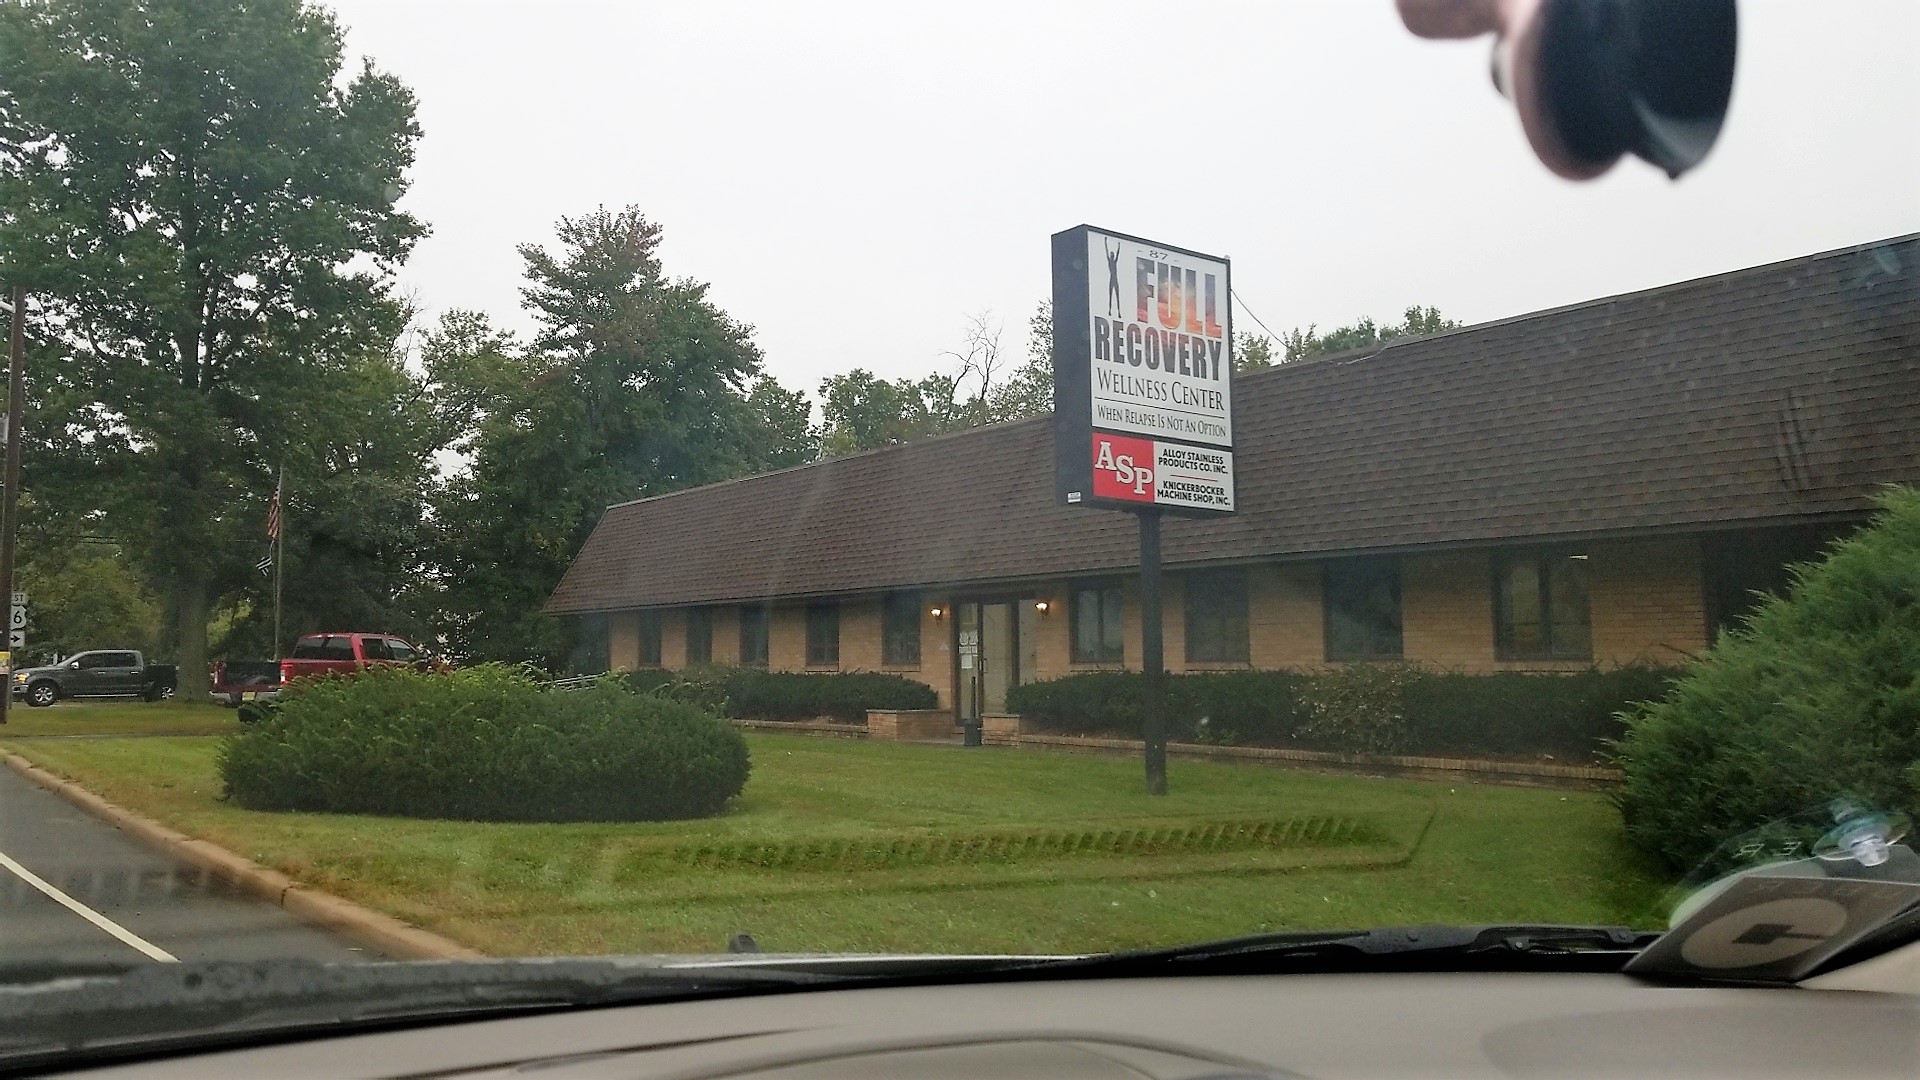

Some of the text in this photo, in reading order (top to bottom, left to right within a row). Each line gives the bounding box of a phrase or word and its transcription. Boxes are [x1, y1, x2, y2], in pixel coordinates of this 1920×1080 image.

[1136, 256, 1222, 339] FULL
[1094, 315, 1222, 381] RECOVERY
[1097, 367, 1225, 411] WELLNESS CENTER
[1097, 404, 1227, 438] WHEN RELAPSE IS NOT AN OPTION
[1094, 441, 1154, 495] ASP
[1158, 457, 1229, 475] PRODUCTS CO. INC.
[1162, 448, 1224, 465] ALLOY STAINLESS
[1157, 489, 1231, 506] MACHINE SHOP, INC.
[1162, 480, 1225, 496] KNICKERBOCKER
[13, 611, 22, 624] 6
